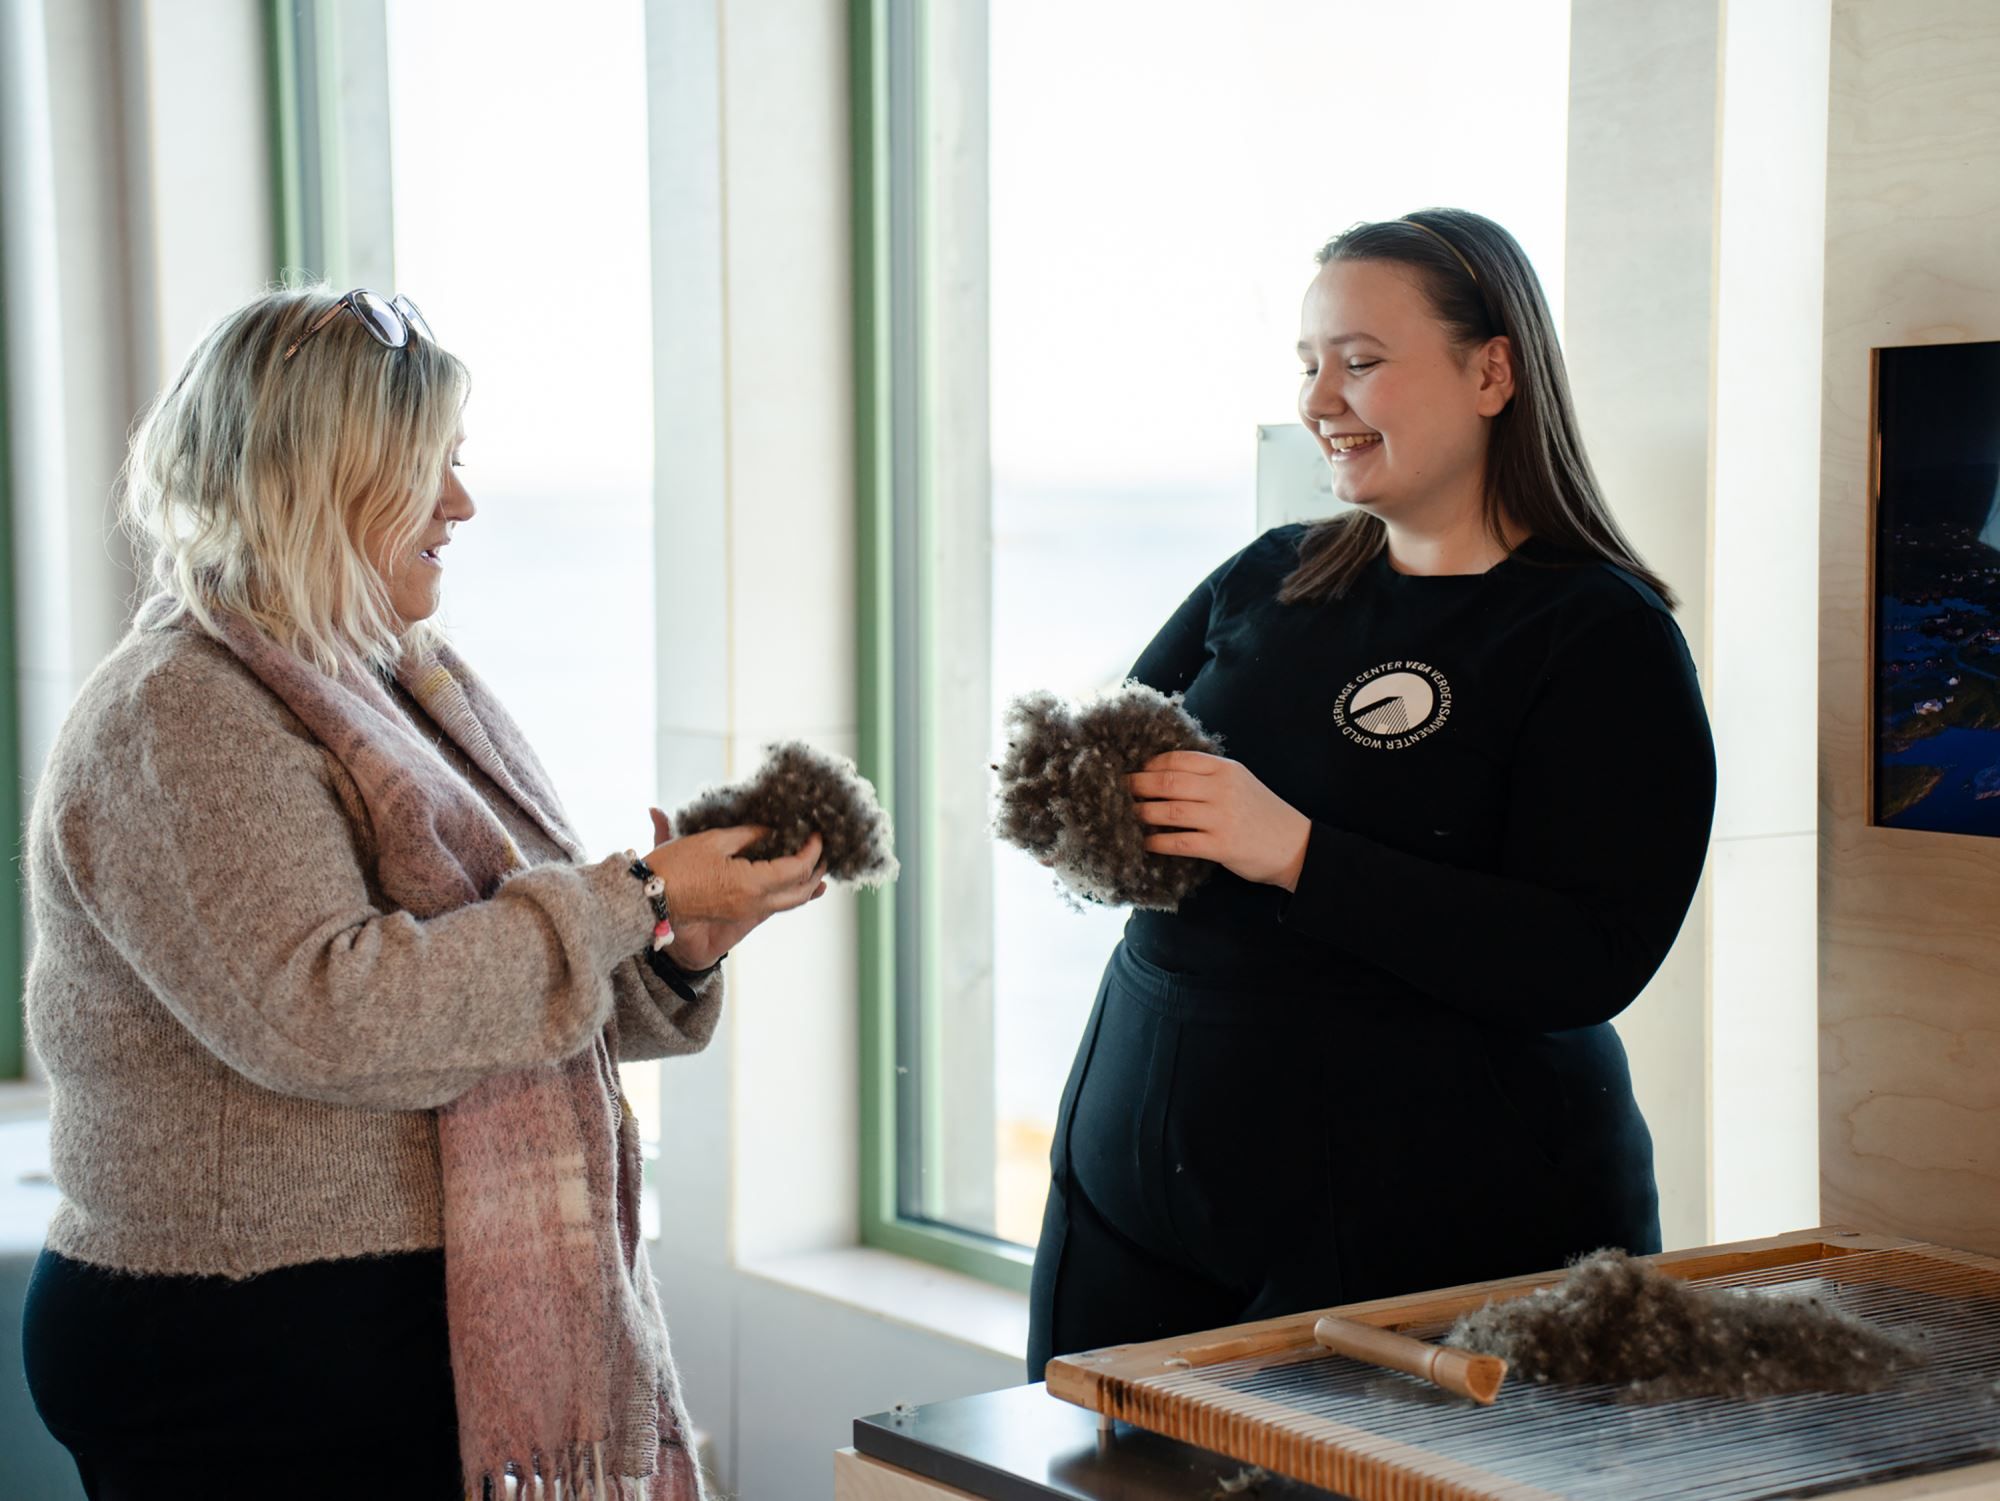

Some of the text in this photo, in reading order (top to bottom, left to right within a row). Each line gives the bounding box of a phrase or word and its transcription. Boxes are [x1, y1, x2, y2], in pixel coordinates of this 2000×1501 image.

[1333, 661, 1452, 750] VEGA VERDENSARVSENTER WORLD HERITAGE CENTER
